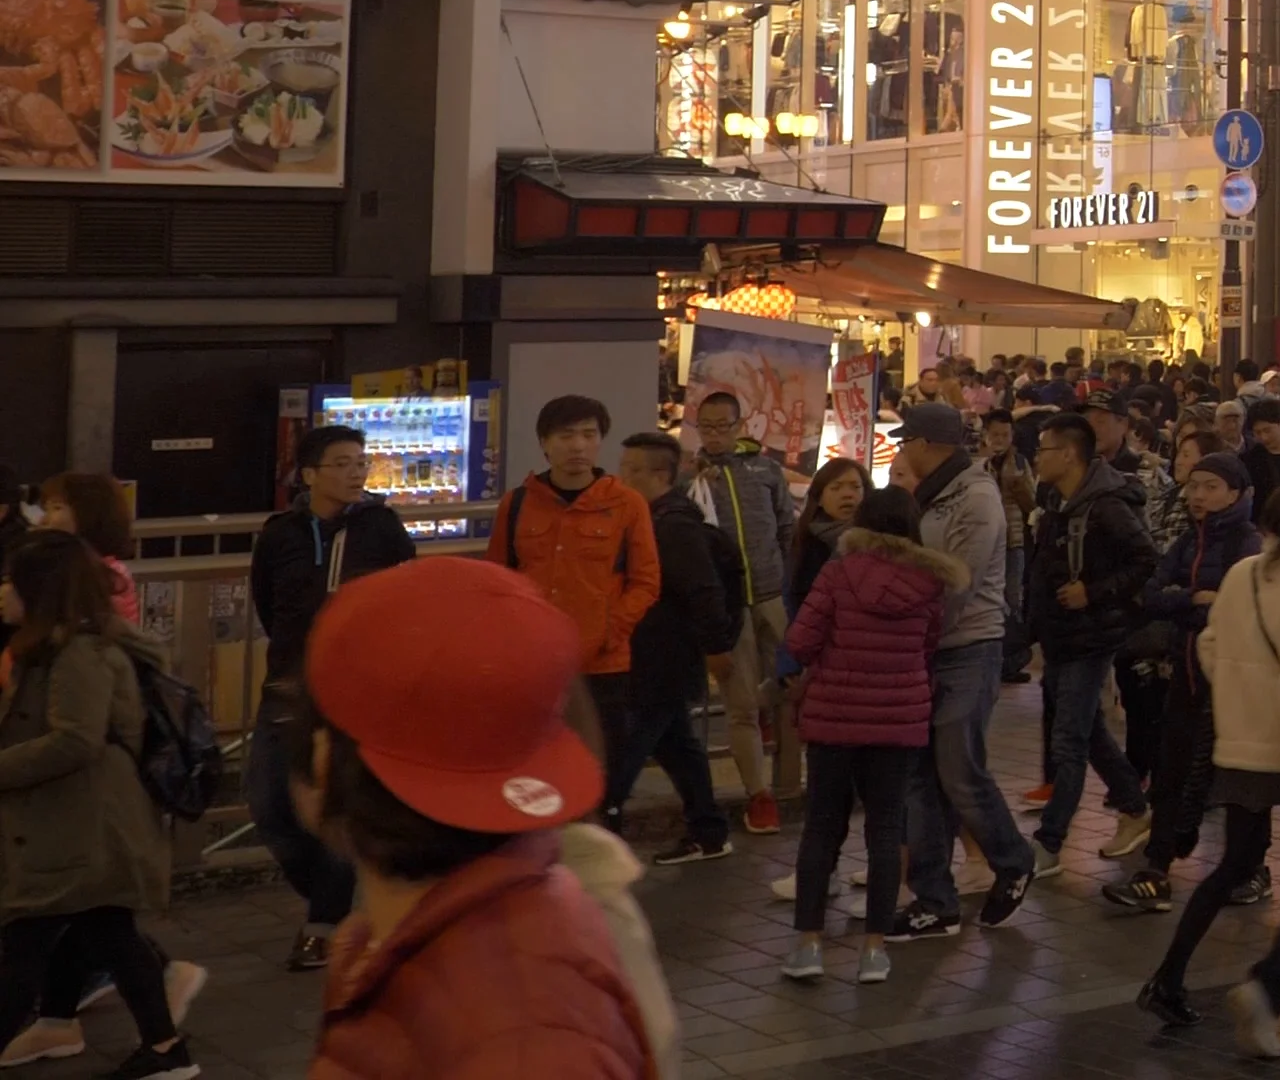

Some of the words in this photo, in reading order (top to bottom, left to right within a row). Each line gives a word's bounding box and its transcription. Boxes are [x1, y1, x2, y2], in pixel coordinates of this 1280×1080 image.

[987, 46, 1034, 254] FOREVER
[1050, 192, 1129, 229] FOREVER
[1136, 191, 1155, 225] 21
